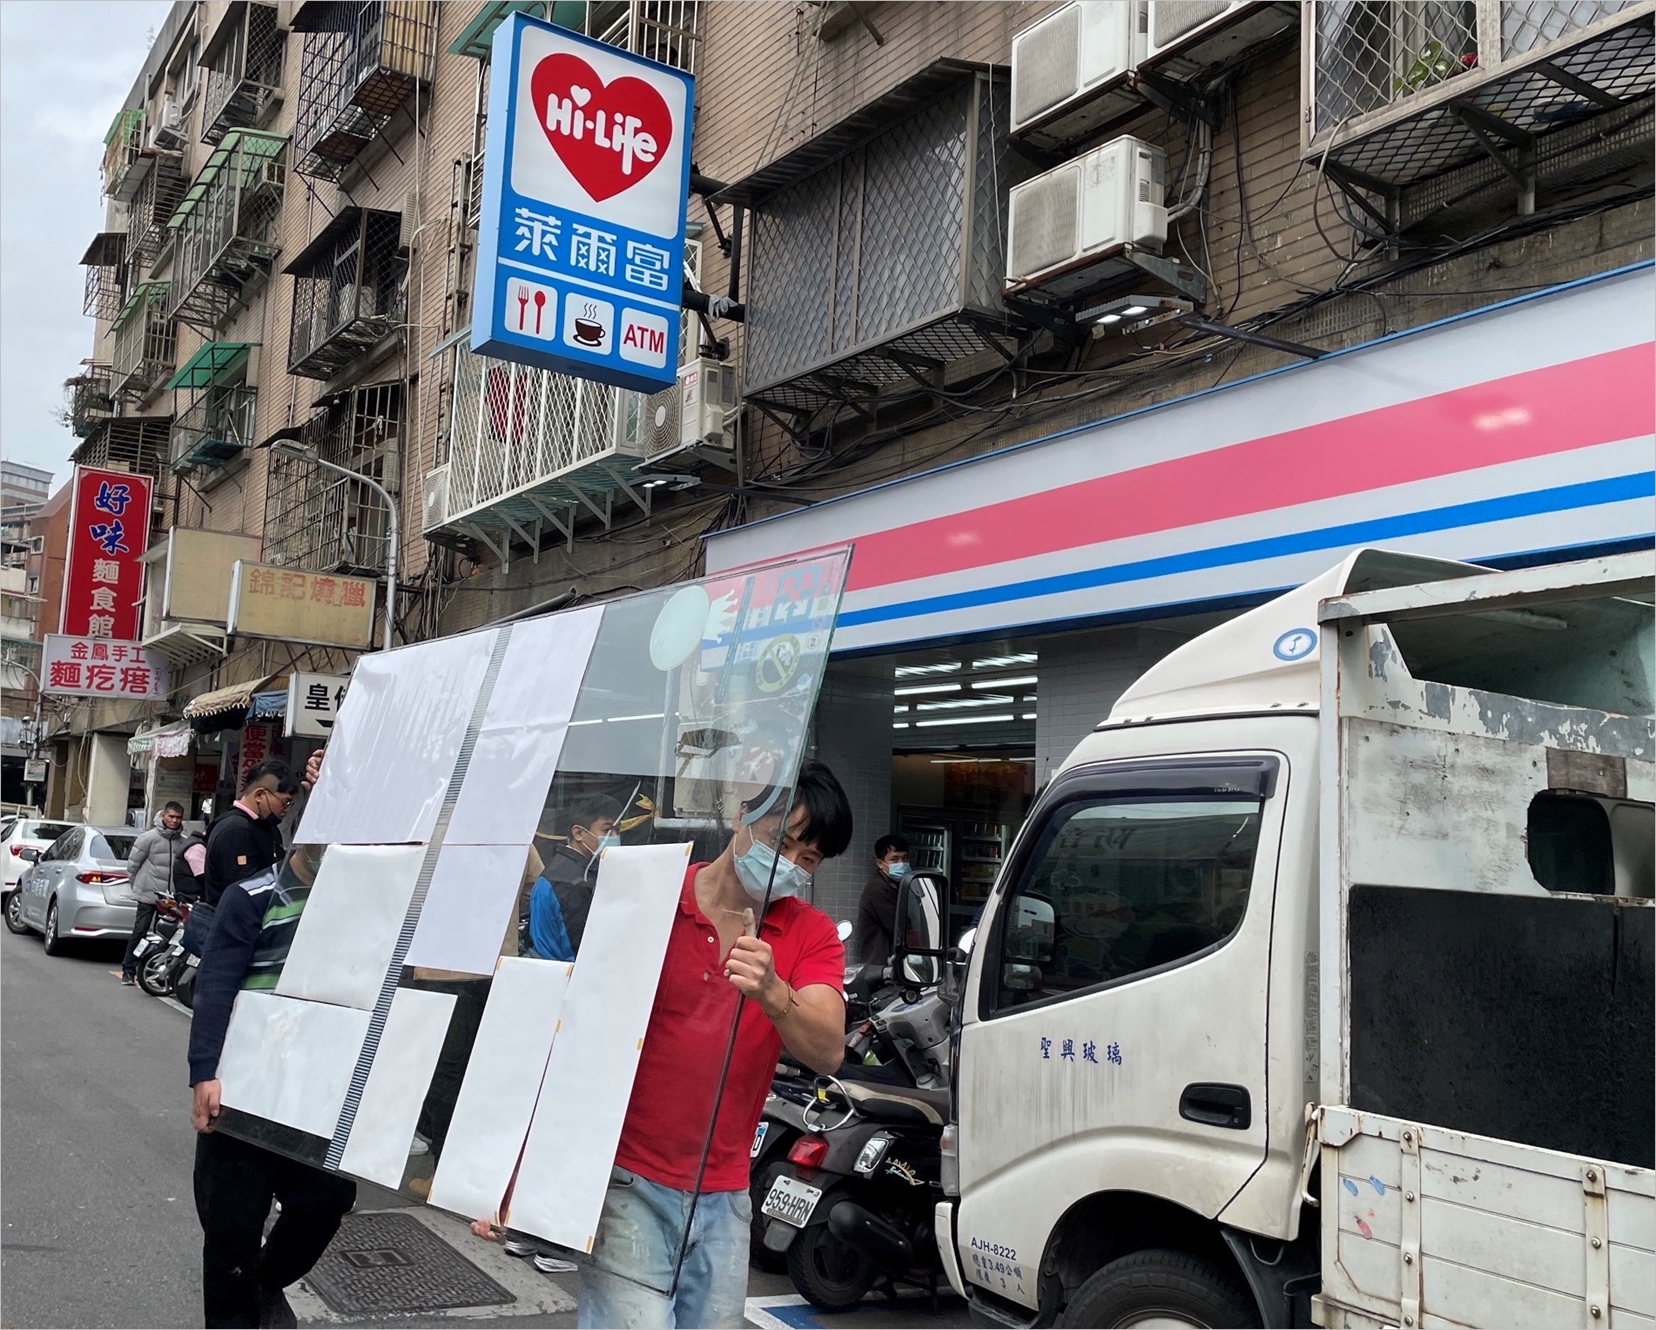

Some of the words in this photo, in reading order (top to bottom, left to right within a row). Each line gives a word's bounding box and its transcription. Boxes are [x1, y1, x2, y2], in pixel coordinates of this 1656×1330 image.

[546, 84, 658, 176] Hi-Life
[514, 207, 670, 292] 萊爾富
[623, 323, 665, 354] ATM
[89, 481, 131, 639] 好味麵食館
[71, 642, 146, 663] 金鳳手工
[50, 660, 151, 694] 麵疙瘩
[1041, 1037, 1123, 1066] 聖興玻璃
[766, 1189, 814, 1220] 959-HRN
[971, 1237, 1016, 1261] AJH-8222
